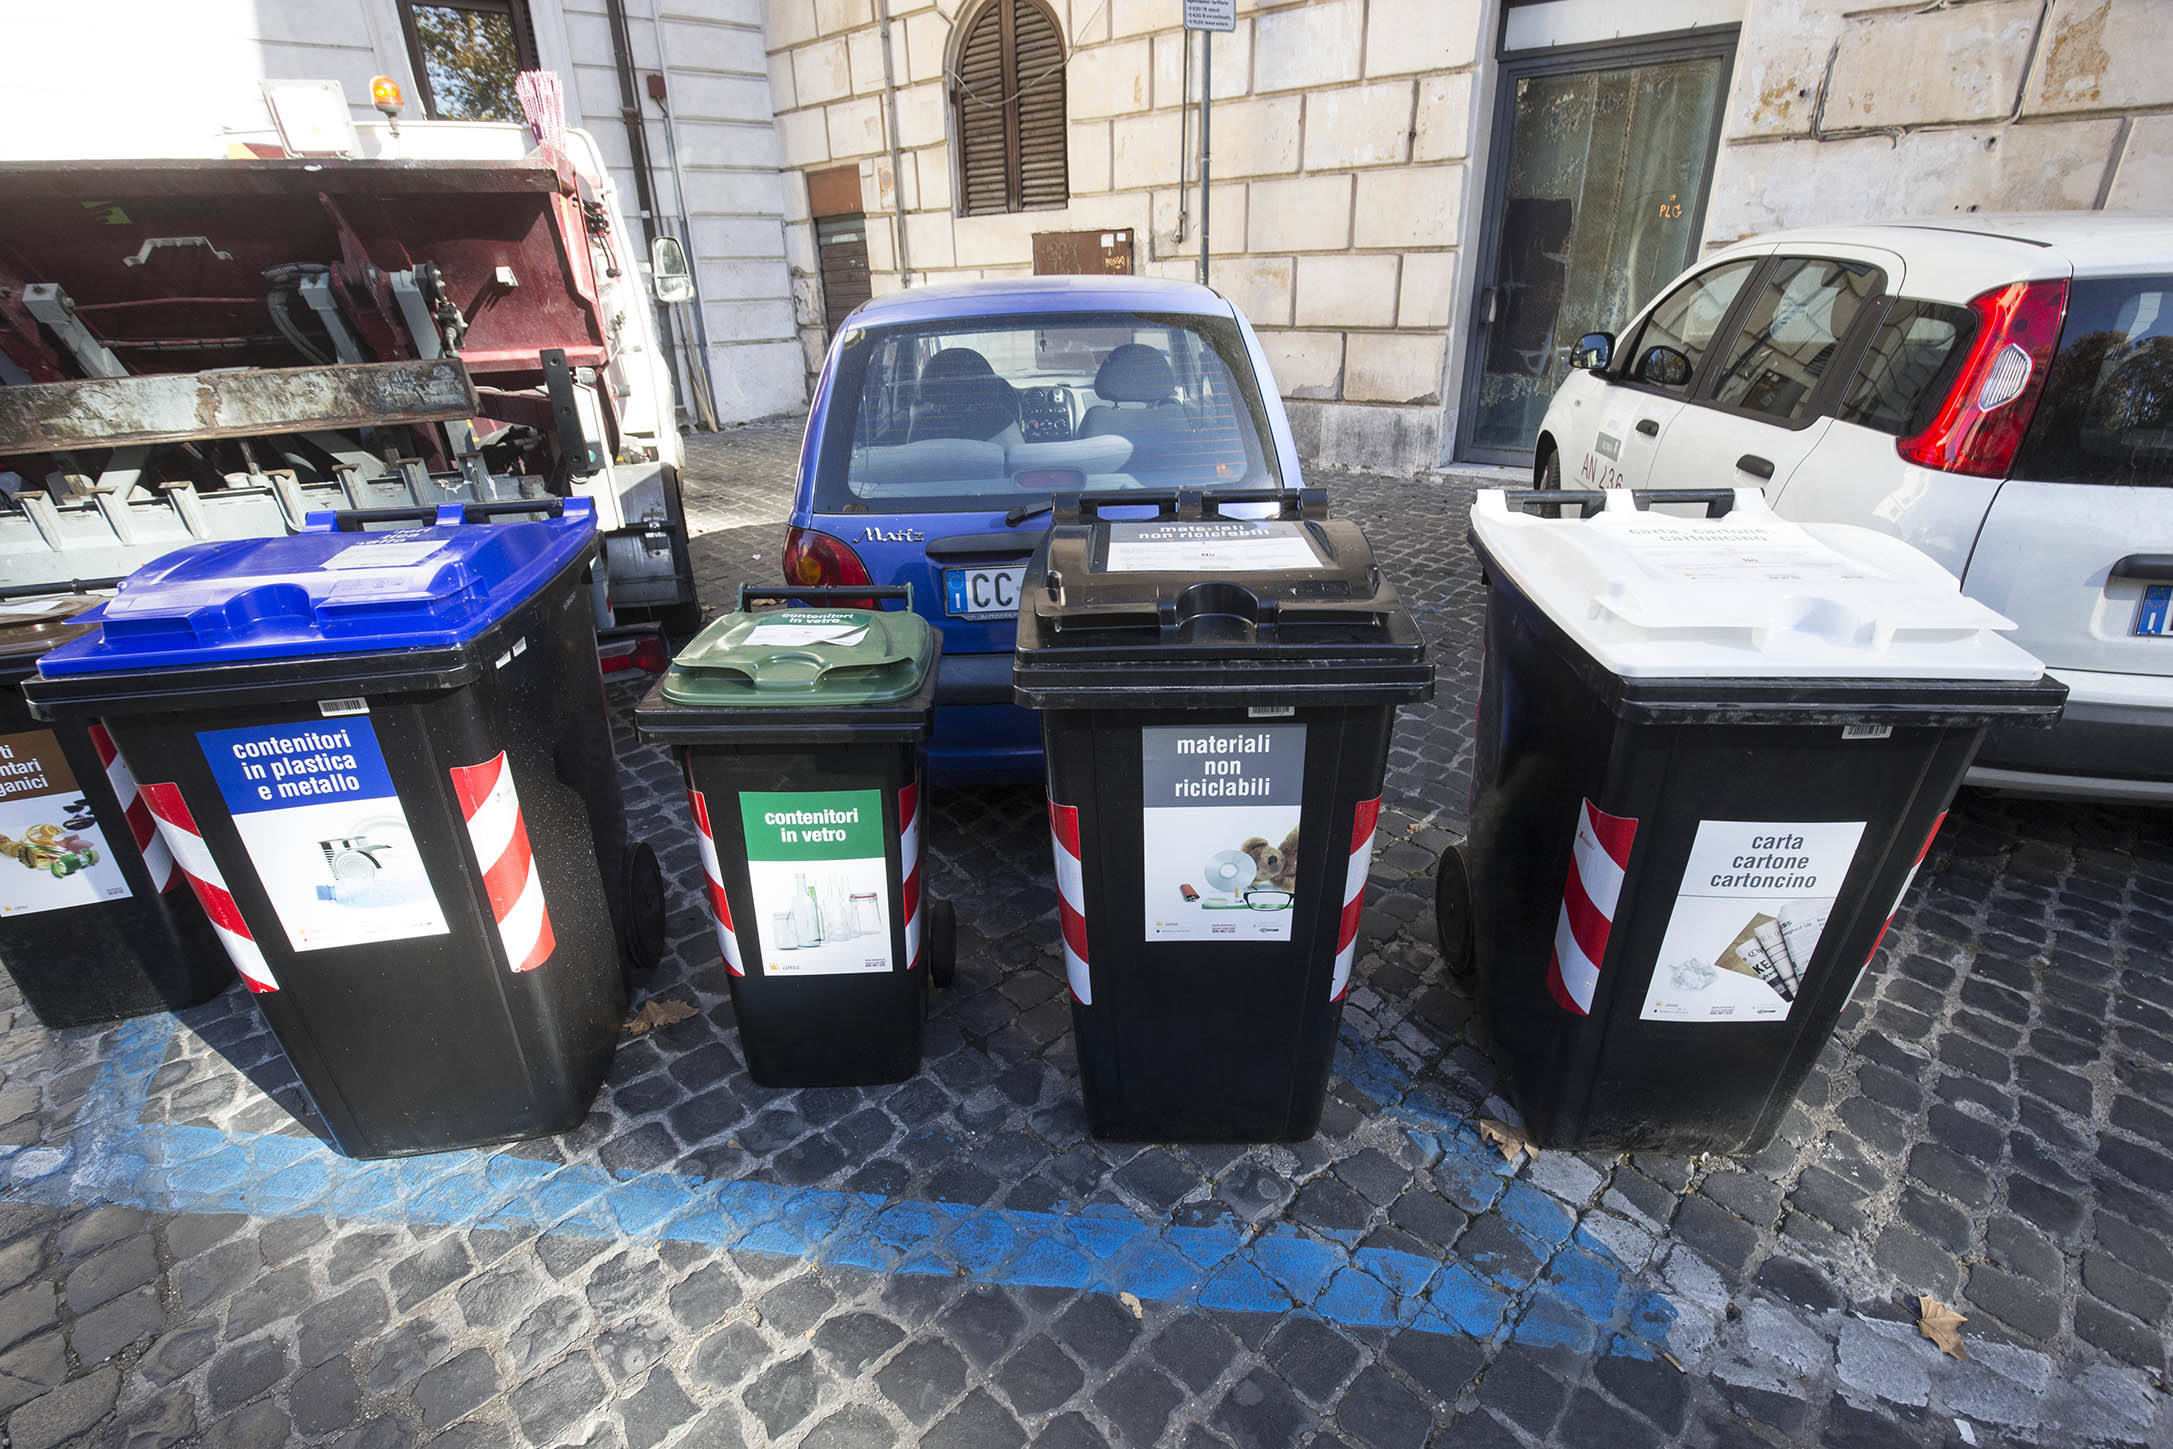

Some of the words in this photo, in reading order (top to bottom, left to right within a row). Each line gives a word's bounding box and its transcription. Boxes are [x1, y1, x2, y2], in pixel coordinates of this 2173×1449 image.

[1581, 452, 1598, 483] AN
[853, 527, 925, 544] Matiz
[1139, 531, 1173, 539] non
[1180, 528, 1270, 539] riciclabili
[1160, 524, 1245, 533] materiali
[972, 572, 1013, 608] CC
[232, 729, 352, 759] contenitori
[1177, 734, 1271, 754] materiali
[242, 762, 267, 780] in
[271, 753, 357, 781] plastica
[1205, 760, 1241, 775] non
[258, 785, 273, 801] e
[278, 773, 360, 799] metallo
[1175, 778, 1271, 797] riciclabili
[765, 808, 859, 825] contenitori
[781, 828, 798, 843] in
[801, 827, 847, 843] vetro
[1751, 834, 1804, 850] carta
[1732, 854, 1810, 870] cartone
[1710, 873, 1817, 888] cartoncino
